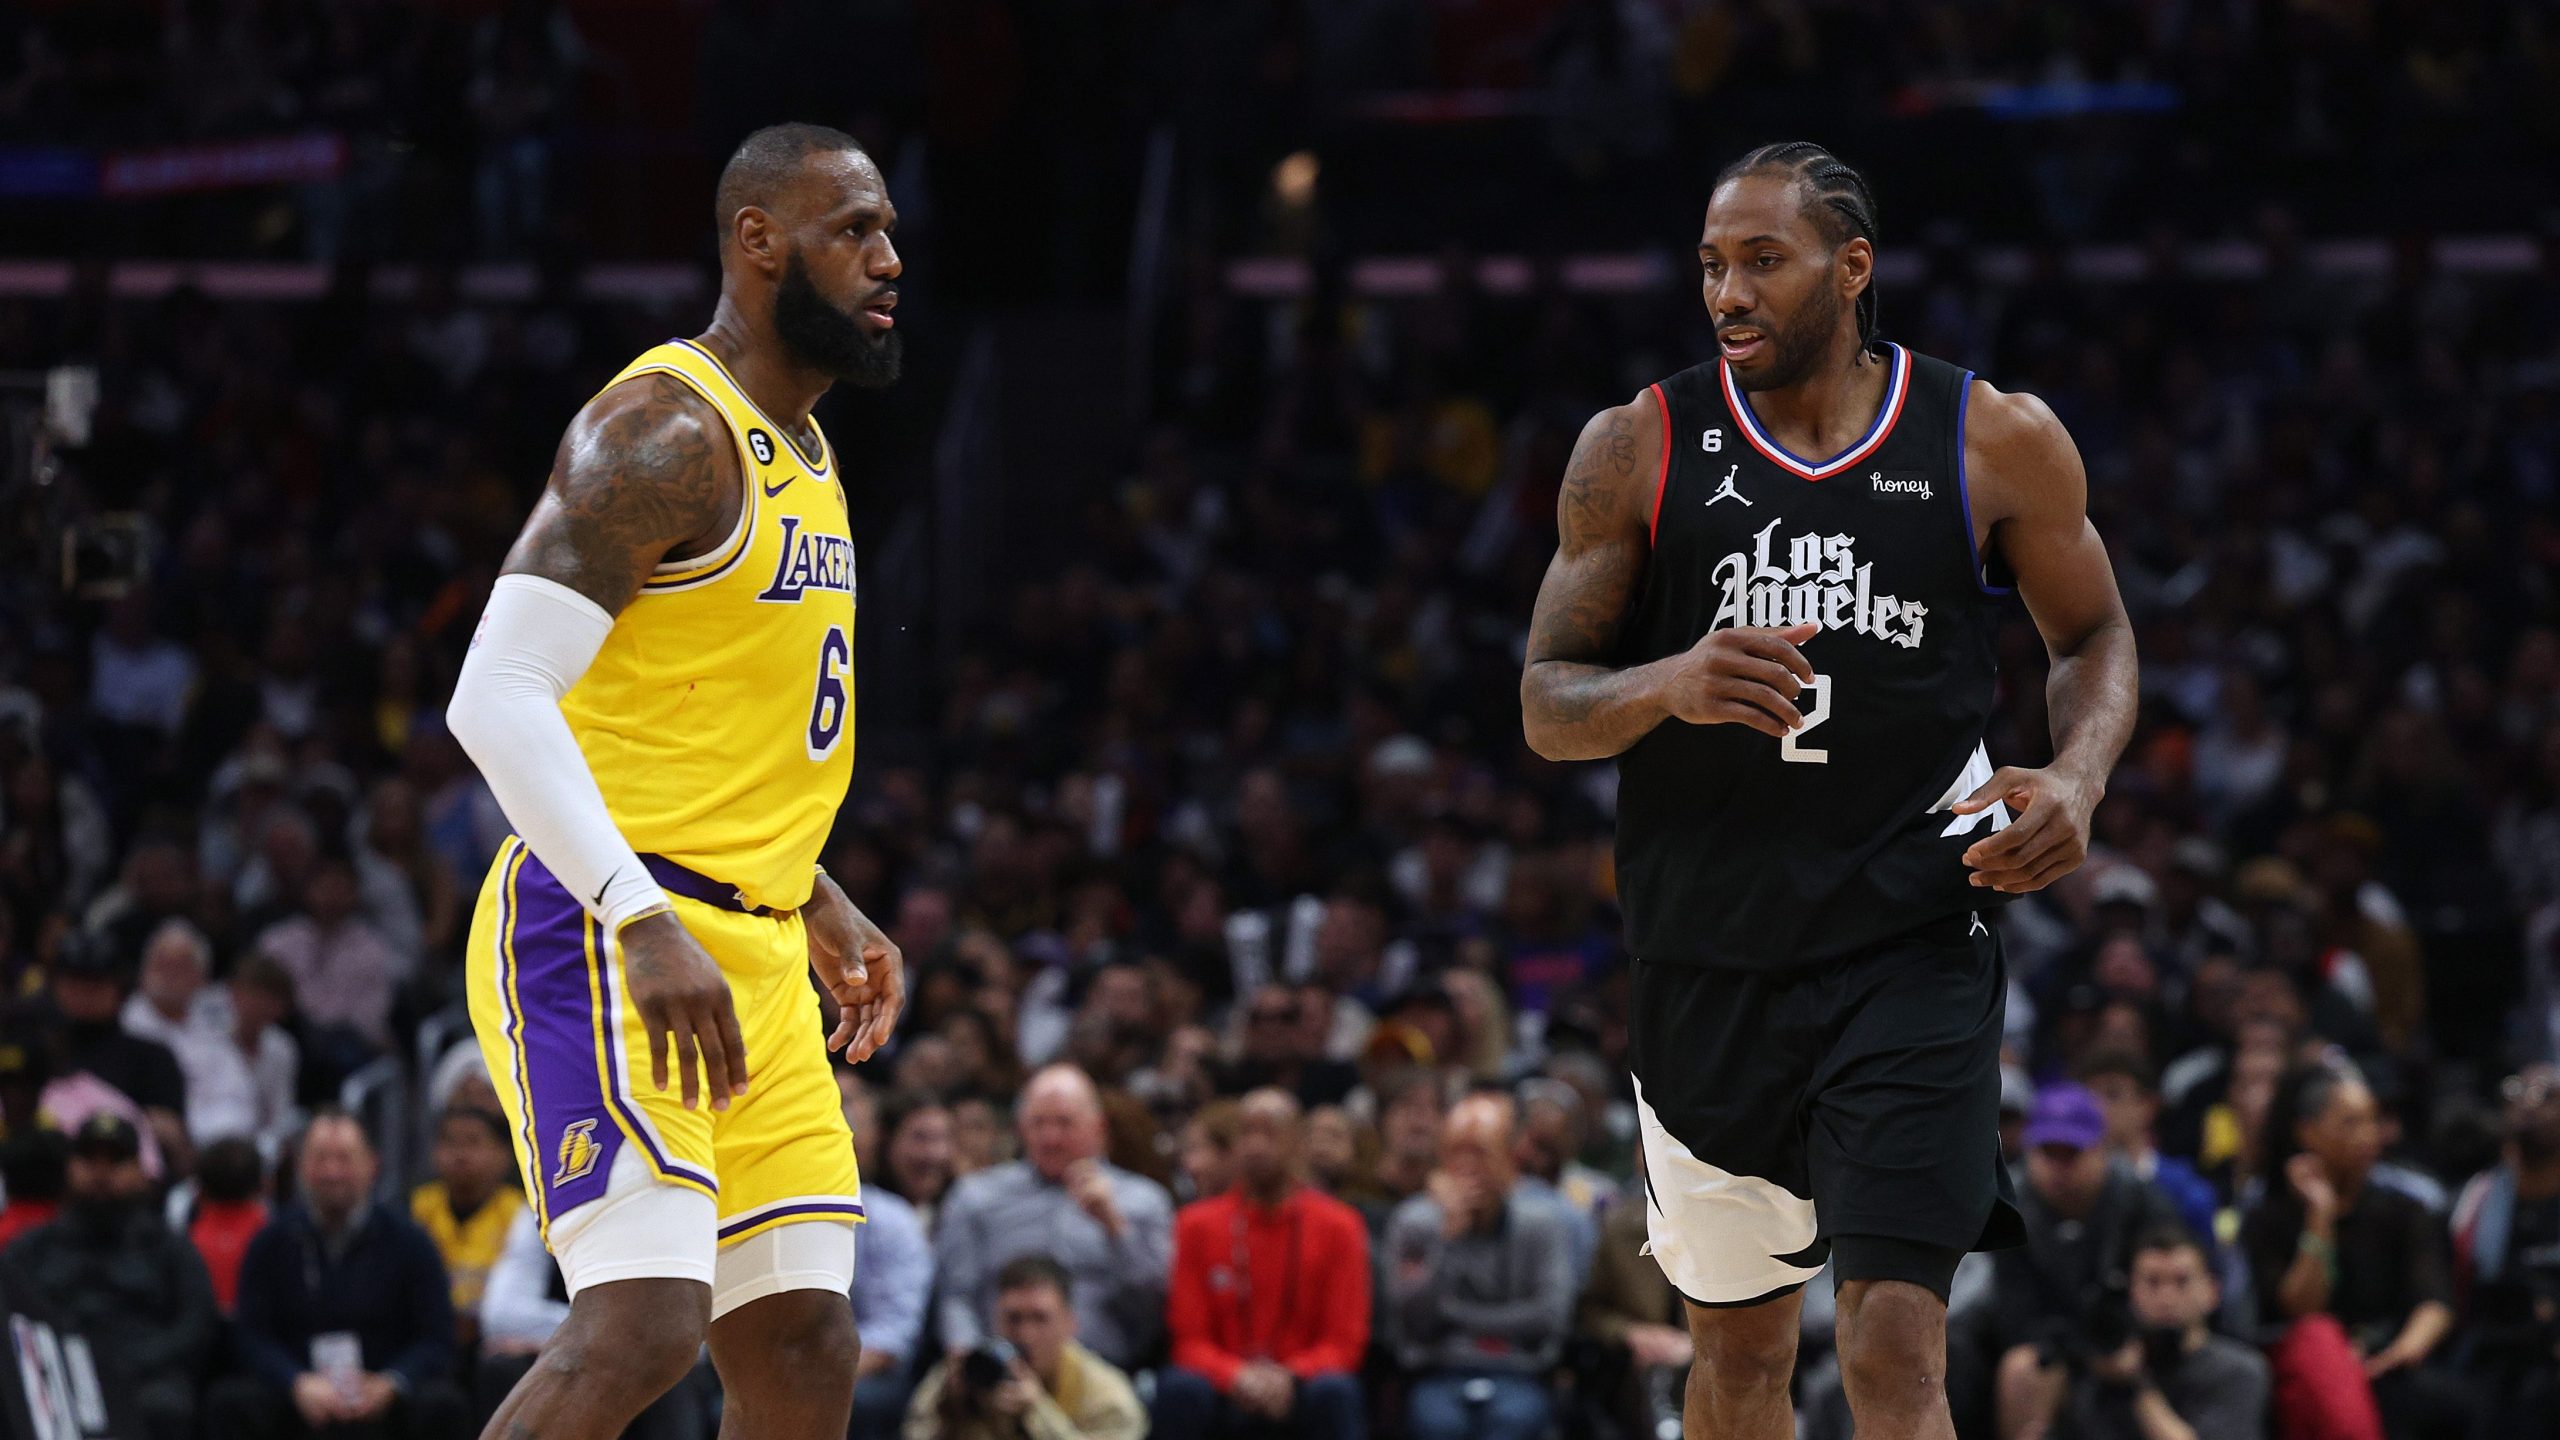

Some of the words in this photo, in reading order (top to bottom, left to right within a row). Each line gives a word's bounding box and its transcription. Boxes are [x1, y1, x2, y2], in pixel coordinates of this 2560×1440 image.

[750, 433, 771, 462] 6
[1701, 428, 1723, 453] 6
[1870, 471, 1934, 500] honey
[755, 515, 857, 606] LAKER
[1748, 517, 1856, 585] Los
[1707, 552, 1929, 649] Angeles
[805, 624, 850, 763] 6
[1781, 674, 1832, 764] 2
